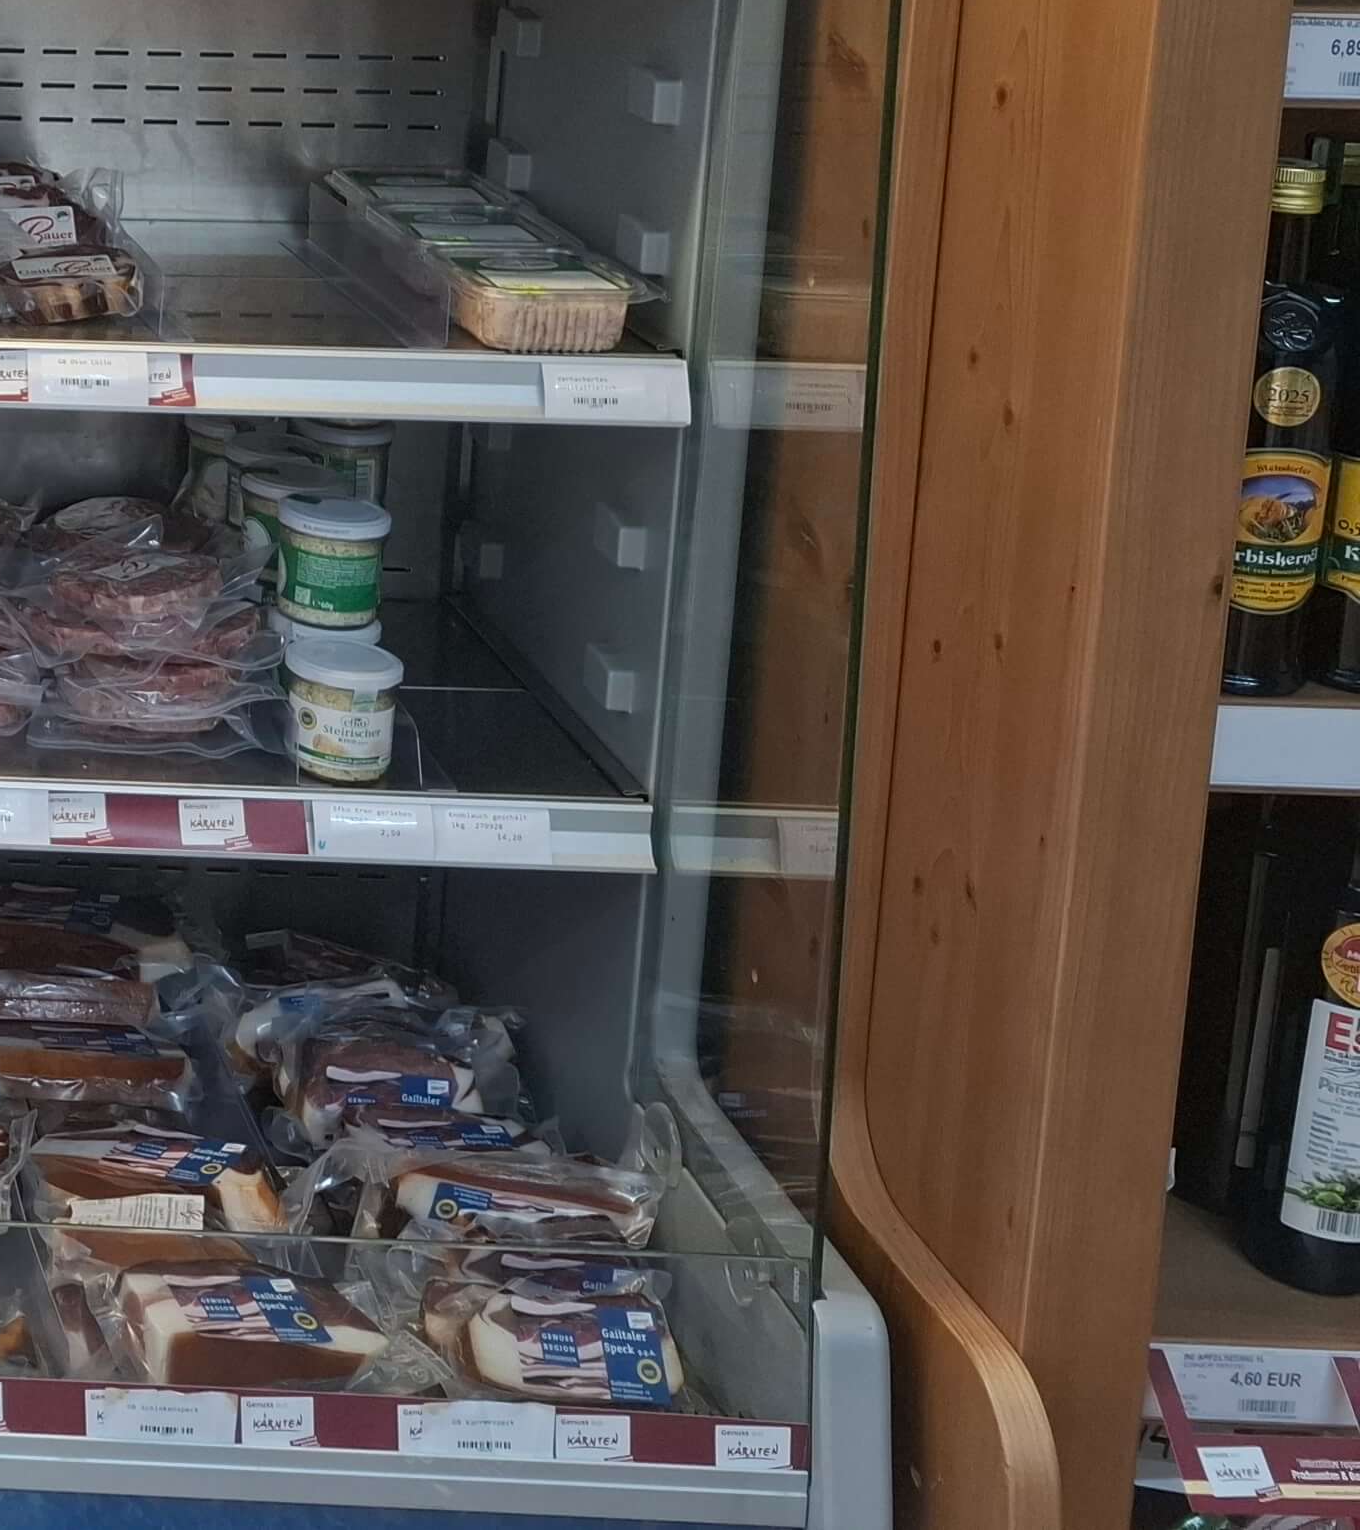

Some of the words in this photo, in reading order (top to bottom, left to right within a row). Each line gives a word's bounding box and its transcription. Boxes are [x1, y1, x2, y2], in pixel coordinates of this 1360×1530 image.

[322, 723, 382, 738] Steirischer
[401, 1092, 442, 1107] Gailtaler
[252, 1290, 294, 1303] Gailtaler
[258, 1301, 287, 1312] Speck
[541, 1332, 575, 1343] GENUSS
[601, 1327, 647, 1342] Gailtaler
[543, 1343, 576, 1354] REGION
[603, 1342, 635, 1355] Speck
[1266, 1372, 1302, 1388] EUR
